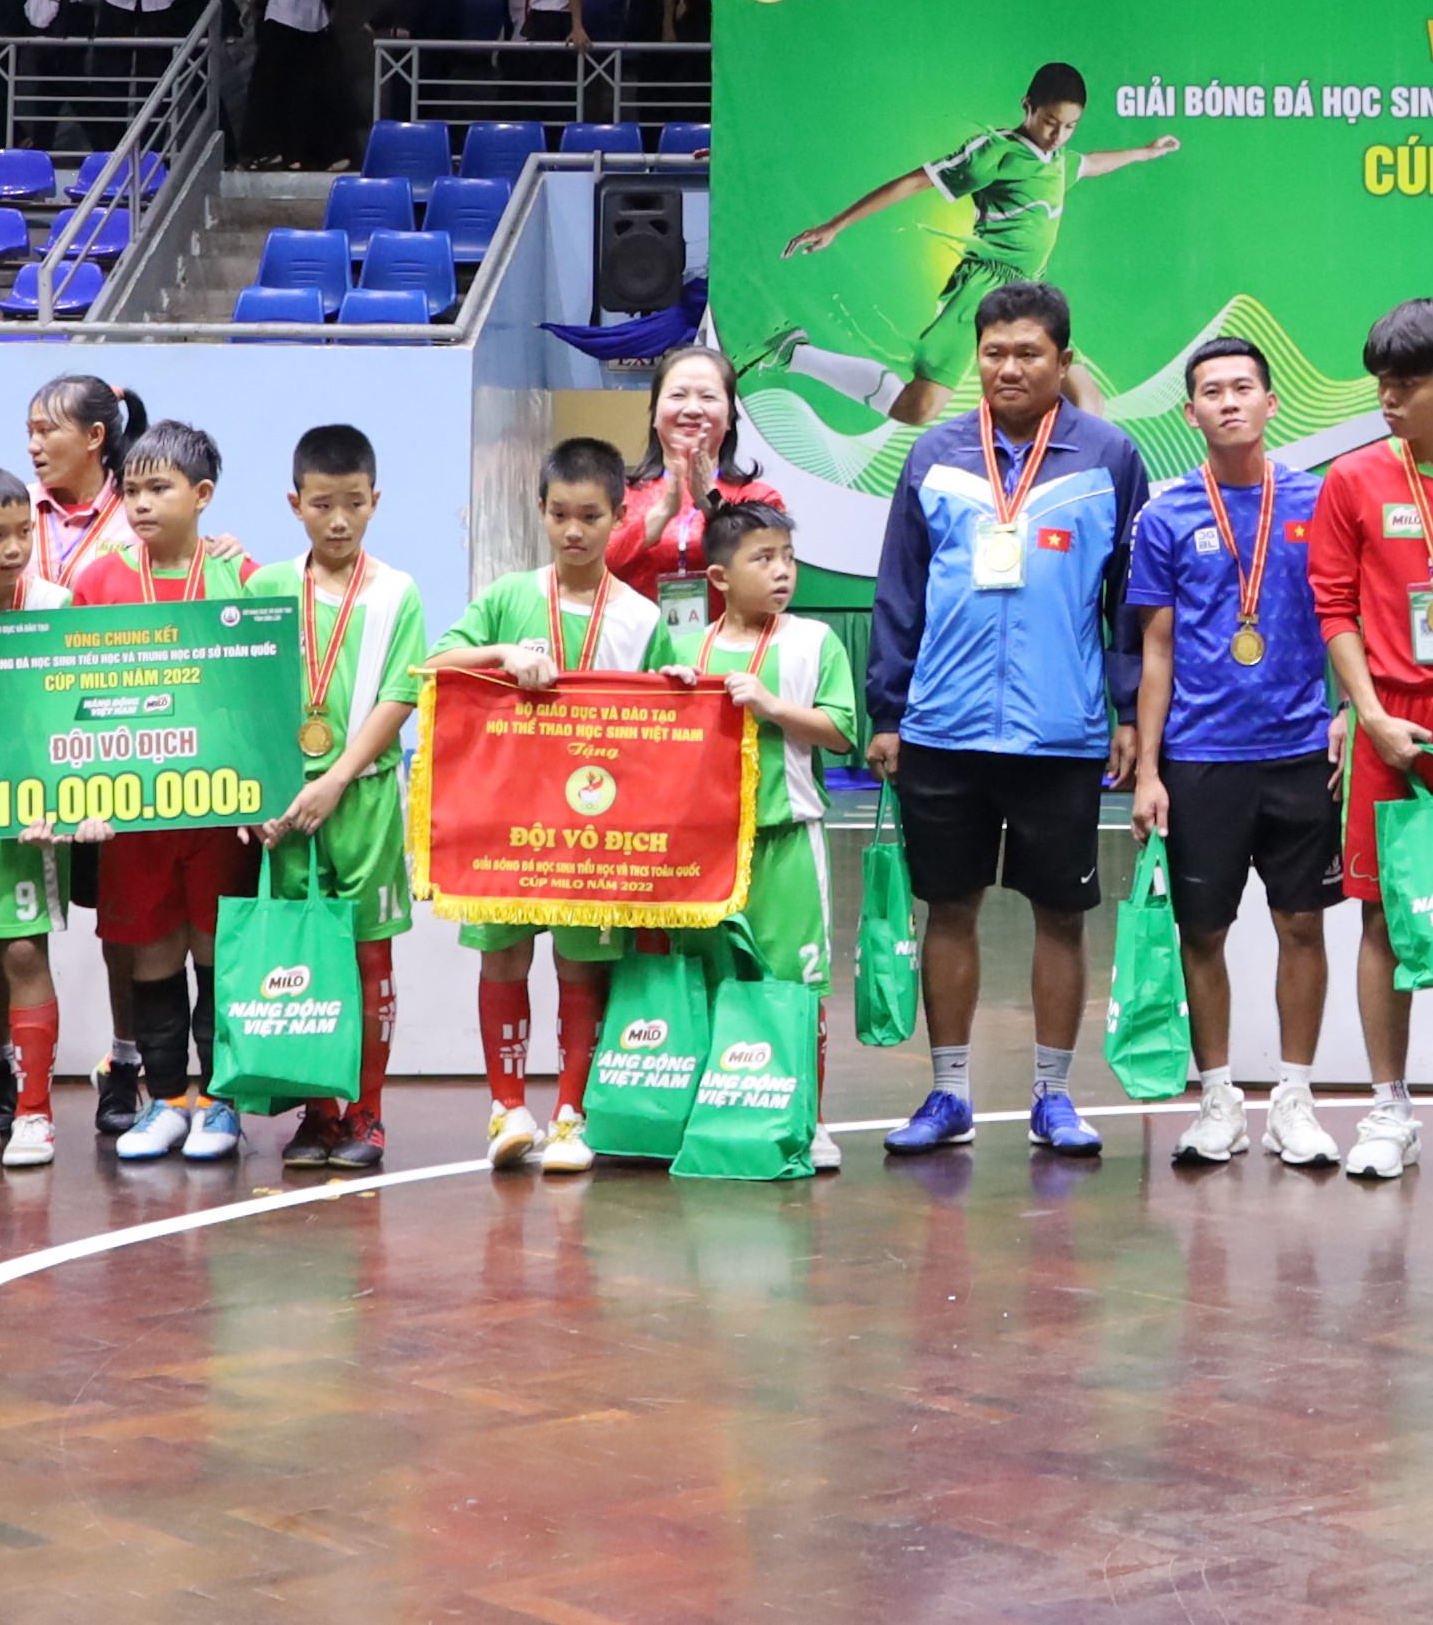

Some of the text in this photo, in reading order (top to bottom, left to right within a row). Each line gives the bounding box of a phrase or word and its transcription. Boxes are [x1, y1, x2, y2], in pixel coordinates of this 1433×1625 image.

[1117, 76, 1175, 117] GIẢI
[1184, 80, 1265, 117] BÓNG
[1273, 80, 1314, 117] ĐÁ
[1323, 86, 1381, 123] HỌC
[65, 626, 178, 647] VÒNG CHUNG KẾT
[15, 656, 29, 669] ĐÁ
[31, 656, 50, 668] HỌC
[53, 655, 76, 666] SINH
[78, 652, 99, 665] TIỂU
[100, 652, 120, 664] HỌC
[122, 651, 135, 662] VÀ
[137, 650, 169, 661] TRUNG
[170, 648, 190, 660] HỌC
[192, 647, 206, 659] CƠ
[208, 644, 221, 658] SỞ
[223, 644, 249, 657] TOÀN
[250, 642, 276, 656] QUỐC
[45, 667, 200, 691] CÚP MILO NĂM 2022
[486, 719, 509, 735] HỘI
[539, 723, 573, 736] THAO
[575, 724, 603, 740] HỌC
[606, 726, 638, 739] SINH
[641, 725, 669, 742] VIỆT
[671, 728, 704, 742] NAM
[52, 728, 196, 766] ĐỘI VÔ ĐỊCH
[509, 822, 668, 855] ĐỘI VÔ ĐỊCH
[15, 881, 37, 920] 9
[798, 942, 821, 982] 2
[269, 976, 304, 990] MILO
[228, 998, 342, 1017] NĂNG ĐỘNG
[244, 1017, 337, 1038] VIỆT NAM
